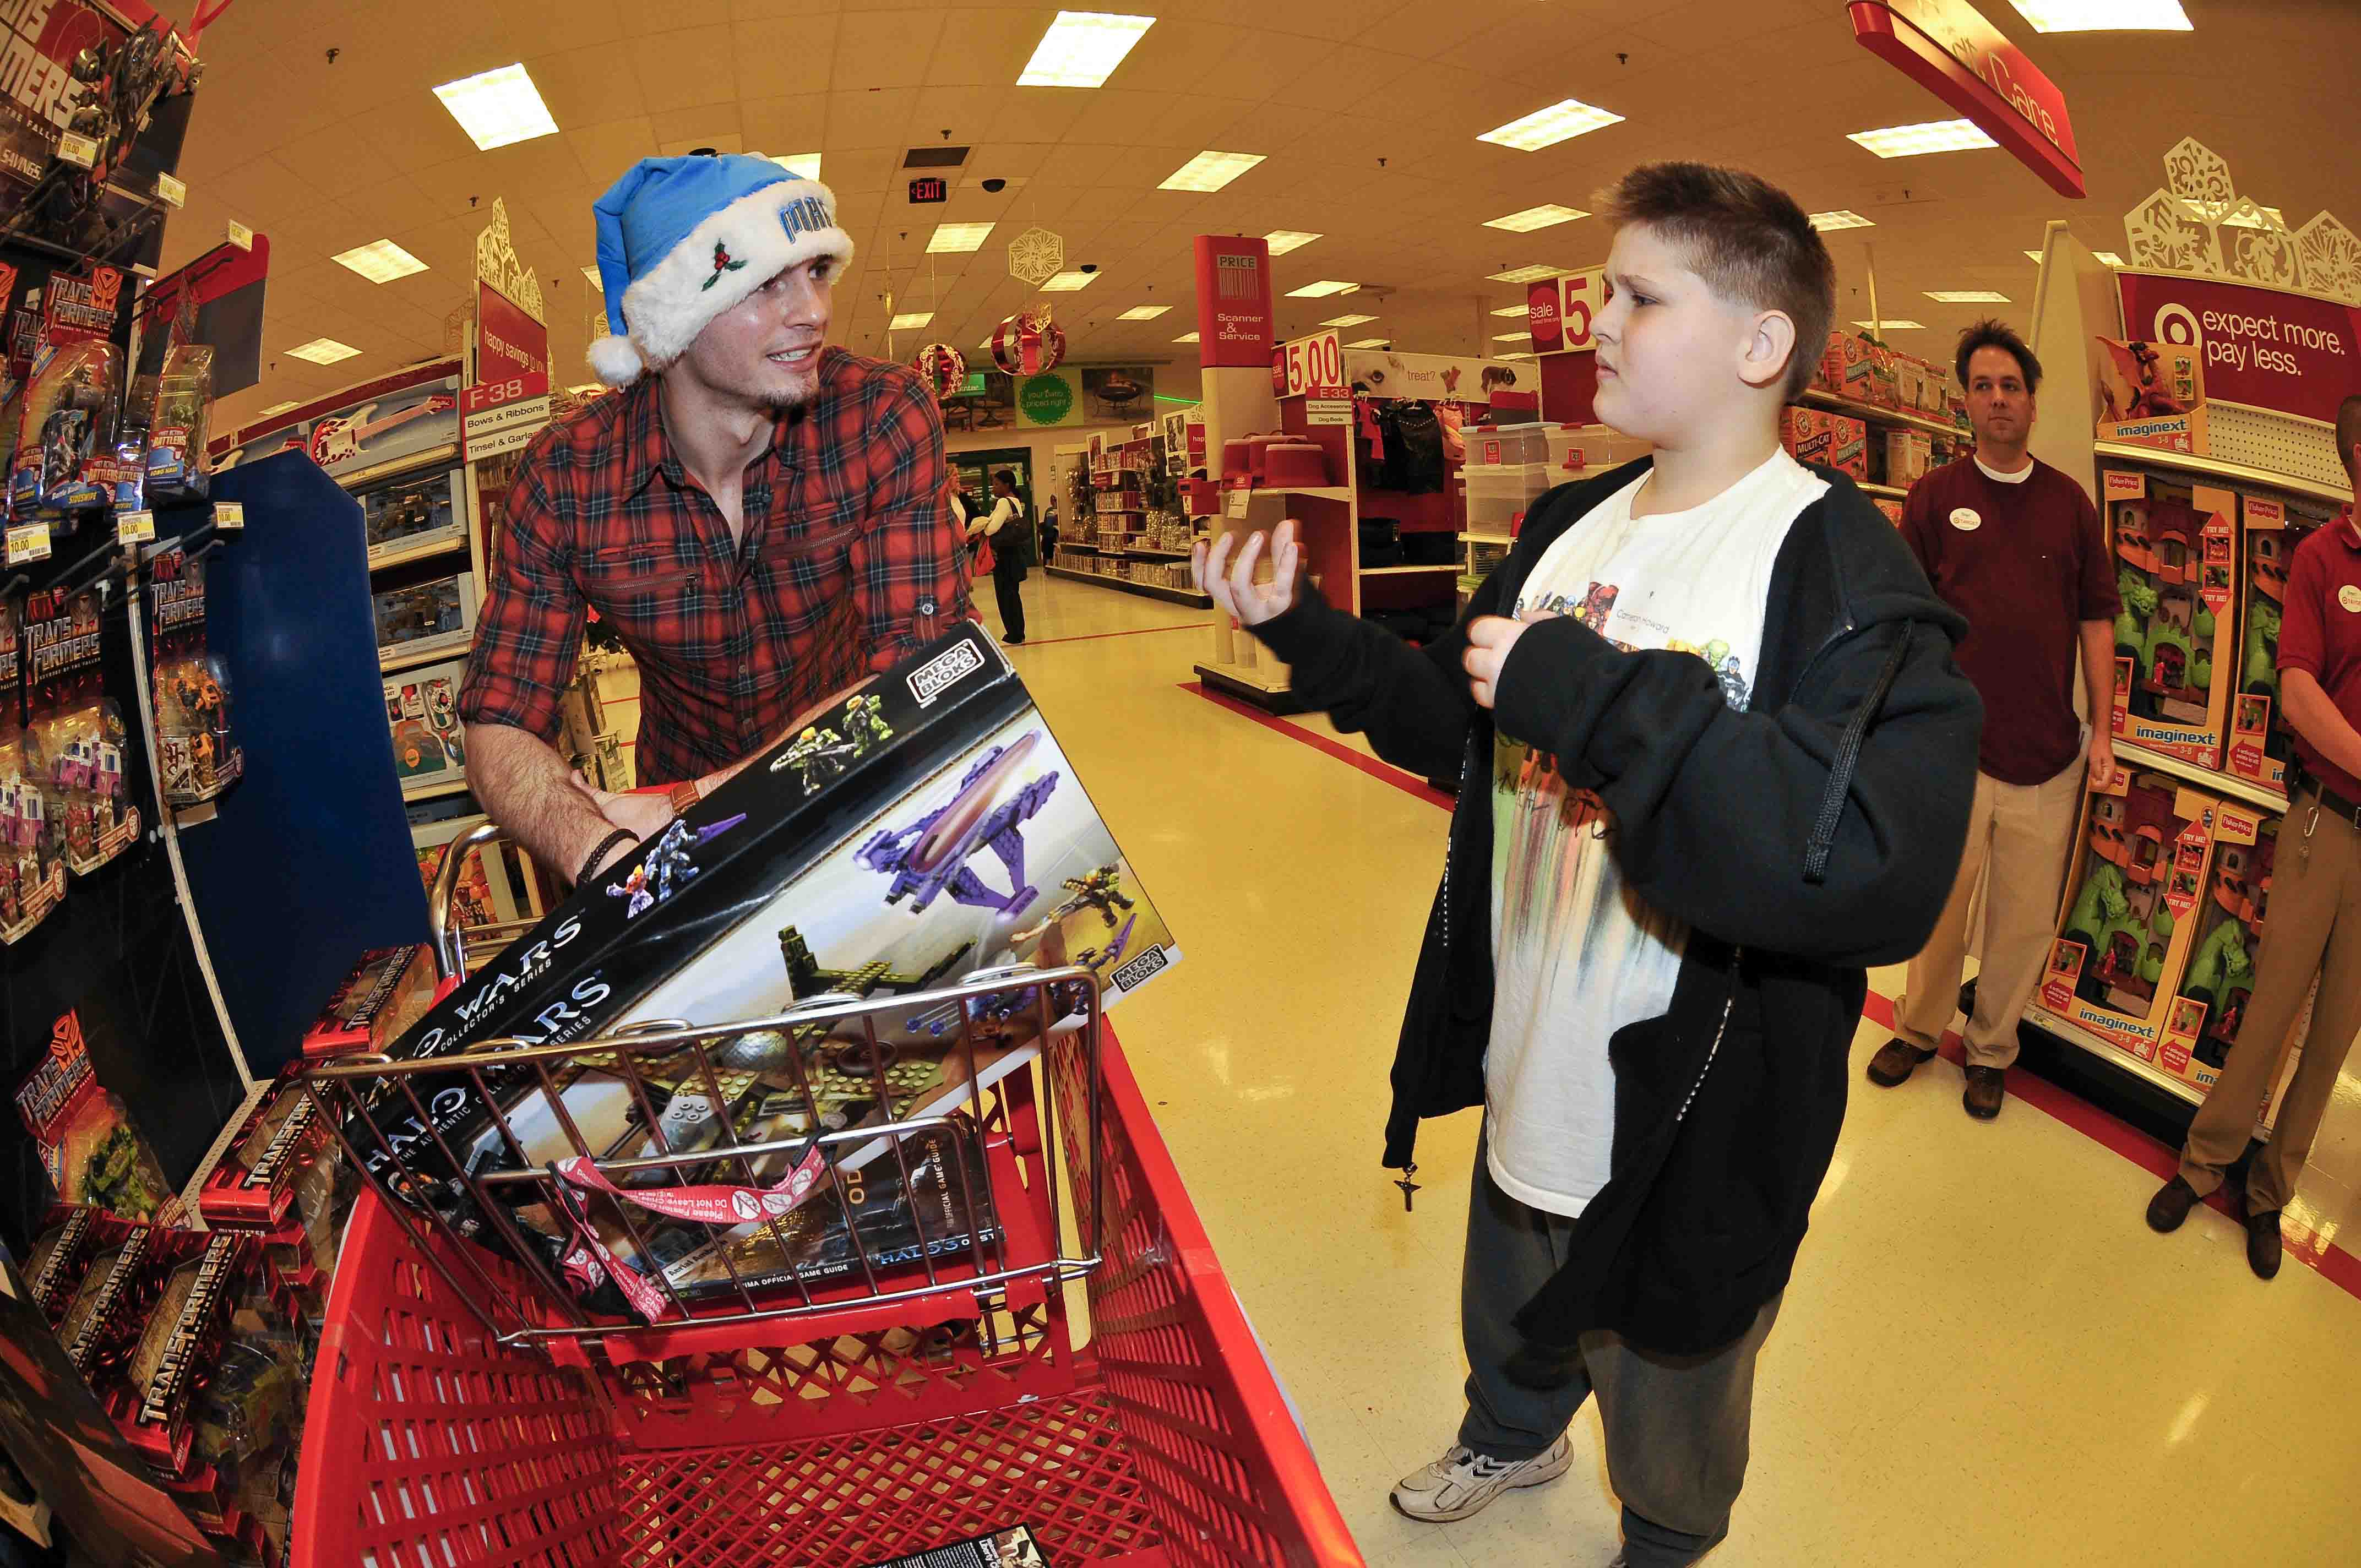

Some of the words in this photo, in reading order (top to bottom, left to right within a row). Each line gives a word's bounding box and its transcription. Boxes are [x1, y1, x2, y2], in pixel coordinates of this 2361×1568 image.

[26, 118, 58, 144] FALLE
[63, 141, 80, 155] 10.00
[916, 182, 941, 199] EXIT
[1219, 256, 1255, 268] PRICE
[1217, 313, 1264, 323] Scanner
[1530, 302, 1553, 319] sale
[1218, 331, 1261, 341] Service
[1226, 323, 1237, 333] &
[2202, 310, 2280, 341] expect
[2283, 322, 2346, 356] more.
[485, 325, 504, 358] happy
[505, 345, 529, 368] savings
[2207, 339, 2246, 371] pay
[2253, 340, 2303, 376] less.
[1288, 334, 1340, 393] 5.00
[1407, 369, 1437, 382] treat?
[467, 416, 493, 428] Bows
[496, 412, 503, 421] &
[505, 404, 545, 419] Ribbons
[2116, 418, 2188, 437] imaginext
[469, 440, 496, 455] Tinsel
[498, 437, 505, 446] &
[507, 431, 536, 444] Garla
[218, 512, 231, 522] 10.00
[121, 524, 138, 535] 10.00
[2218, 526, 2230, 534] ME!
[10, 539, 29, 553] 10.00
[2205, 594, 2217, 602] TRY
[24, 616, 72, 663] TRANS
[34, 633, 102, 686] FORMERS
[914, 646, 971, 687] MEGA
[918, 654, 977, 696] BLOKS
[2136, 725, 2216, 745] imaginext
[2183, 834, 2197, 842] TRY
[2168, 898, 2182, 907] TRY
[454, 915, 581, 1021] WARS
[1116, 950, 1160, 983] MEGA
[1120, 956, 1165, 990] BLOKS
[440, 993, 506, 1052] COLLECTOR'S
[512, 957, 552, 993] SERIES
[550, 1016, 592, 1046] SERIES
[2078, 1007, 2155, 1039] imaginext
[15, 1055, 63, 1125] TRANS
[32, 1047, 92, 1139] FORMERS
[420, 1106, 472, 1148] AUHENTIC
[928, 1137, 941, 1164] GUIDE
[934, 1164, 946, 1189] GAME
[693, 1210, 723, 1220] Please
[696, 1200, 712, 1208] Not
[715, 1199, 727, 1208] Do
[667, 1254, 695, 1277] Aerial
[799, 1269, 822, 1279] GAME
[824, 1264, 849, 1275] GUIDE
[138, 1232, 233, 1426] TRANSFORMERS
